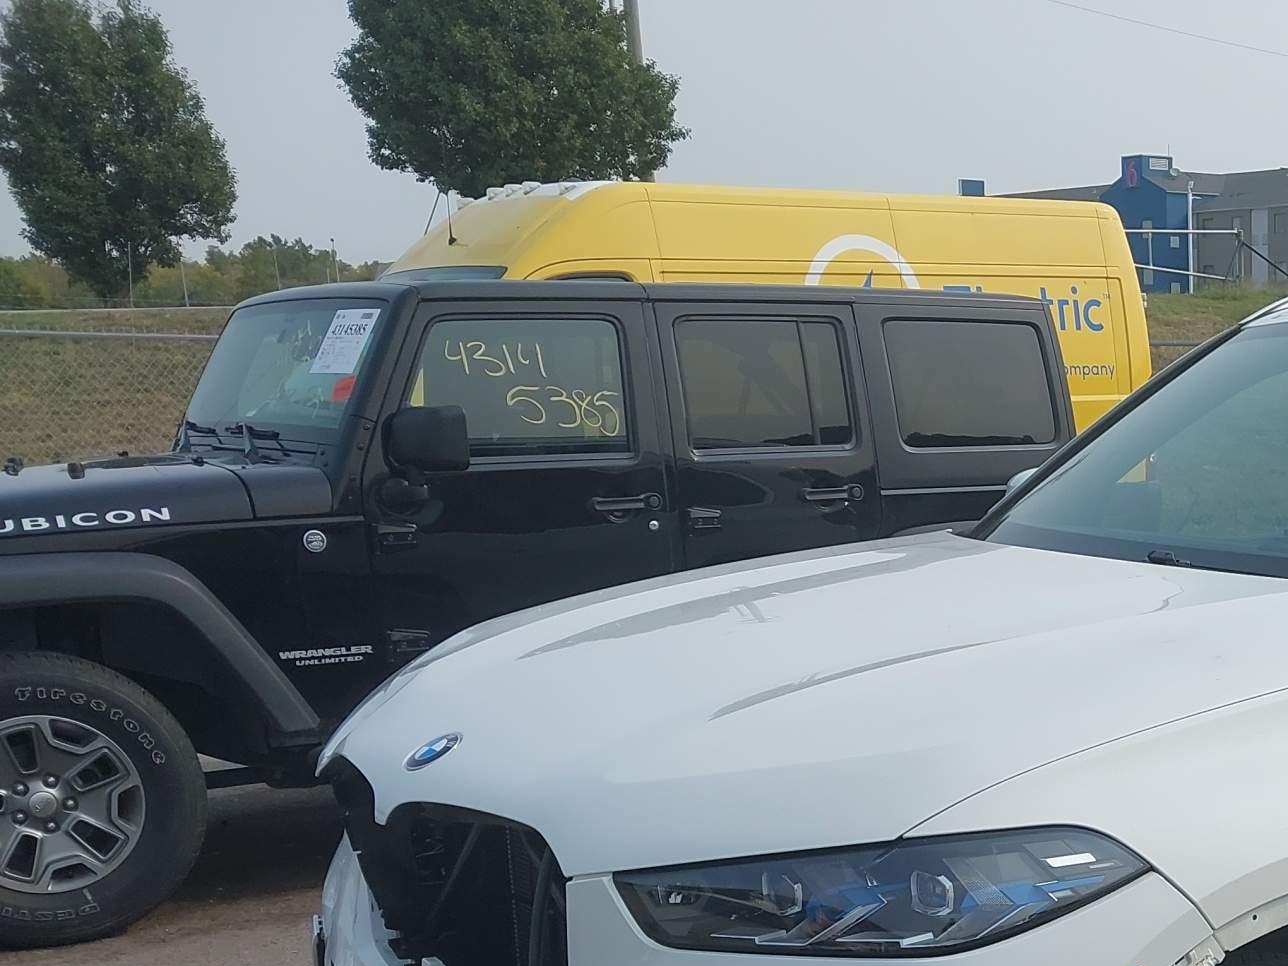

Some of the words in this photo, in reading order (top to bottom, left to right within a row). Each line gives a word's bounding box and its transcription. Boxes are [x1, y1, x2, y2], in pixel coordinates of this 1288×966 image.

[444, 339, 548, 378] 4314
[1064, 363, 1115, 380] ompany
[506, 386, 620, 437] 5385
[0, 507, 171, 534] UBICON
[279, 645, 374, 659] WRANGLER
[295, 655, 364, 666] UNLIMITED
